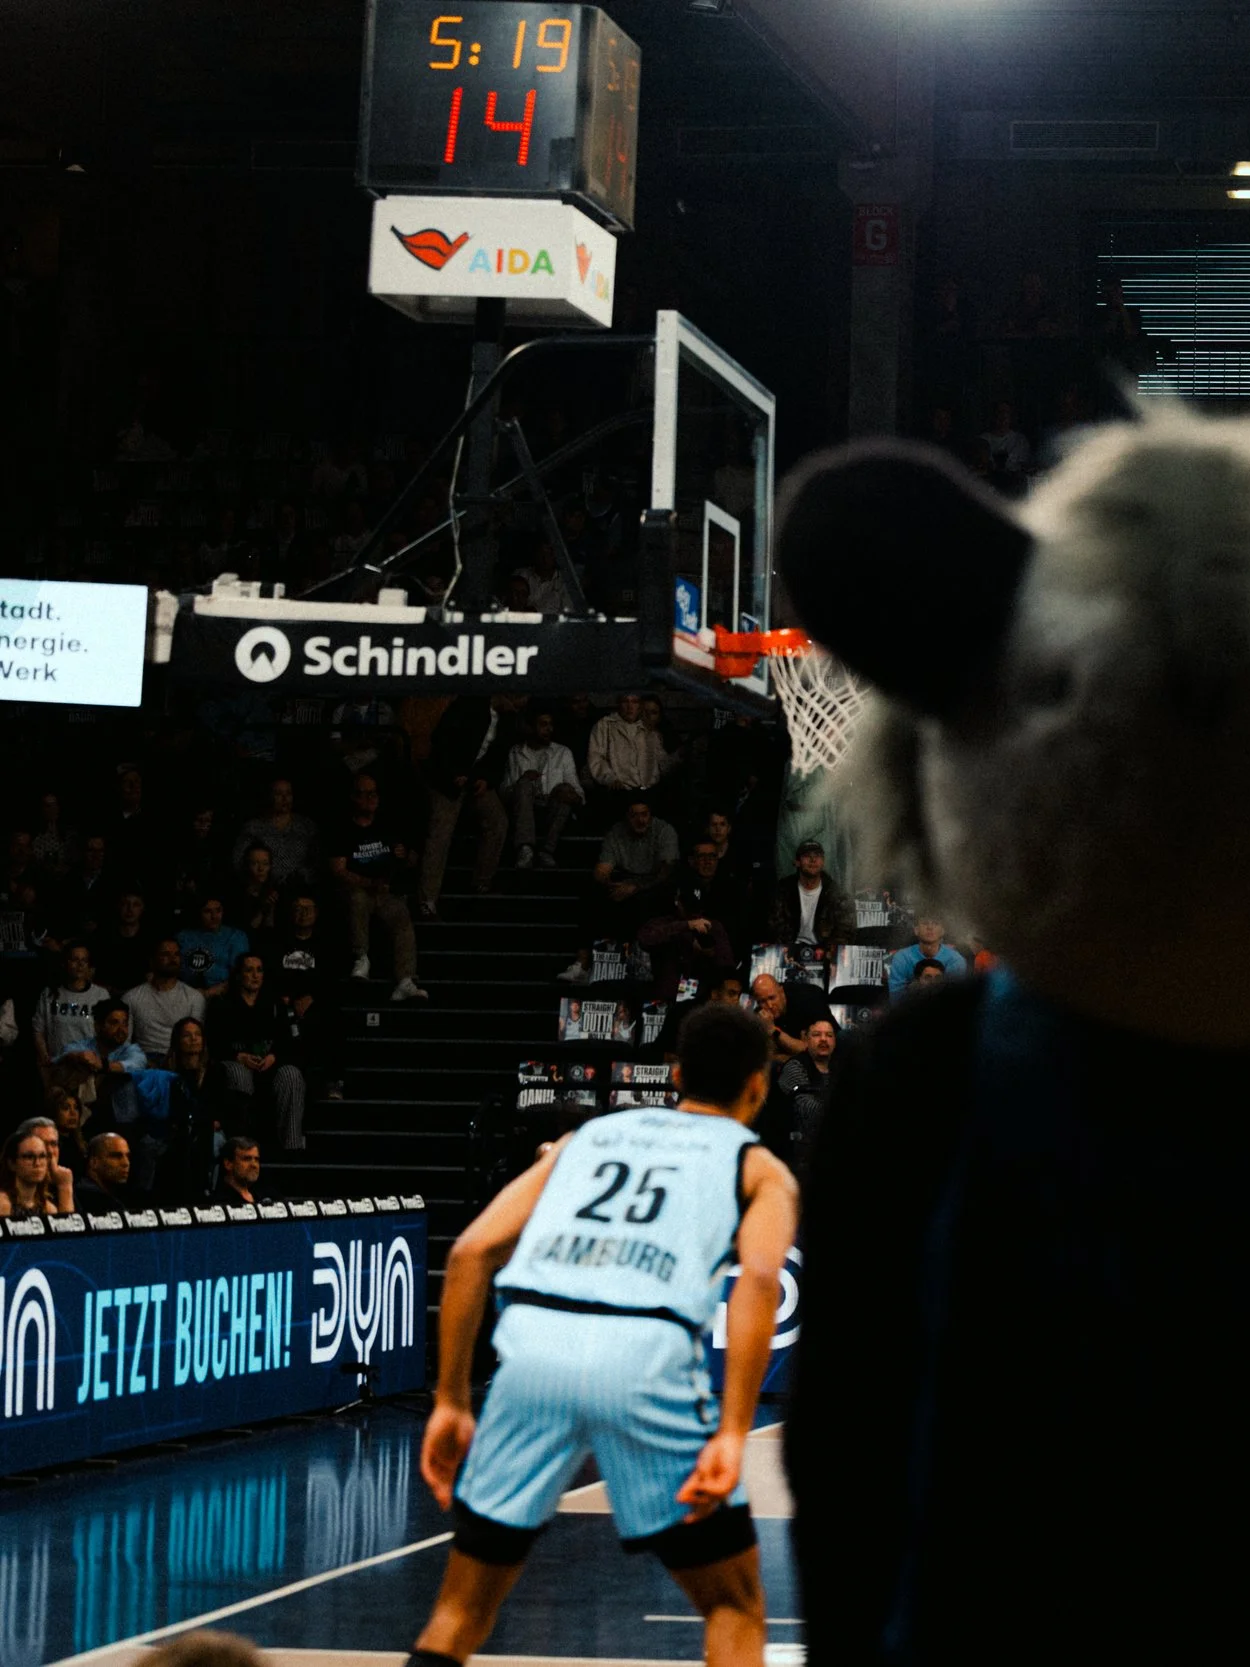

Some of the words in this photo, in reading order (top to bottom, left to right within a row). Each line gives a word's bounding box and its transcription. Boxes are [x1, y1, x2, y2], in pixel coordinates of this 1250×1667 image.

[429, 16, 572, 73] 5:19
[444, 87, 537, 166] 14
[469, 249, 555, 275] AIDA
[866, 220, 887, 250] G
[304, 635, 539, 676] Schindler
[575, 1162, 679, 1224] 25
[77, 1283, 168, 1405] JETZT
[174, 1270, 294, 1387] BUCHEN!
